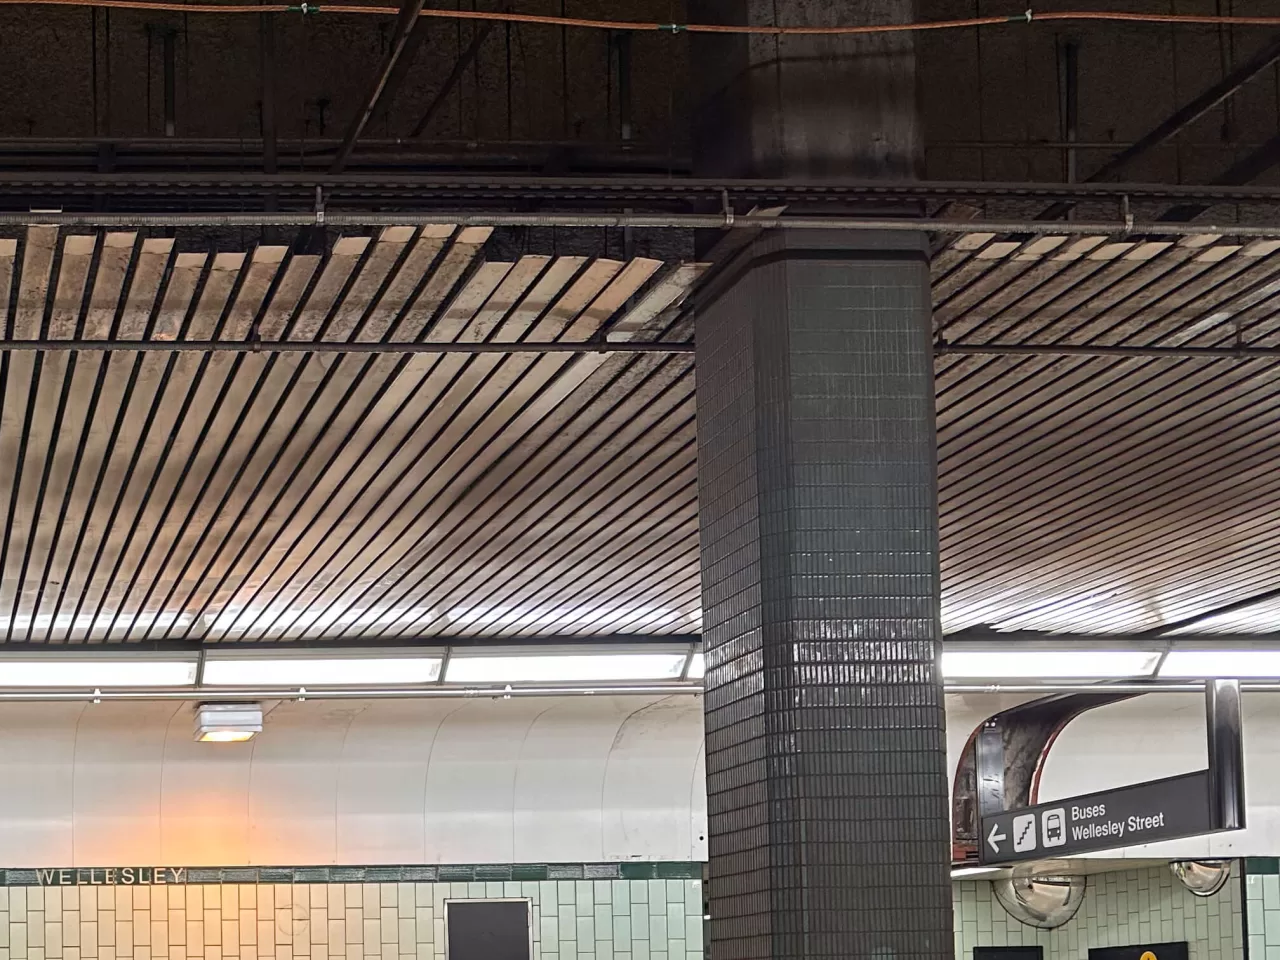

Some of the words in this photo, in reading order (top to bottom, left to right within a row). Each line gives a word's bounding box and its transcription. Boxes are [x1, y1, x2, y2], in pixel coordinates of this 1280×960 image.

[1071, 804, 1106, 821] Buses
[1071, 820, 1125, 841] Wellesley
[1127, 812, 1165, 832] Street
[35, 867, 185, 886] WELLESLEY
